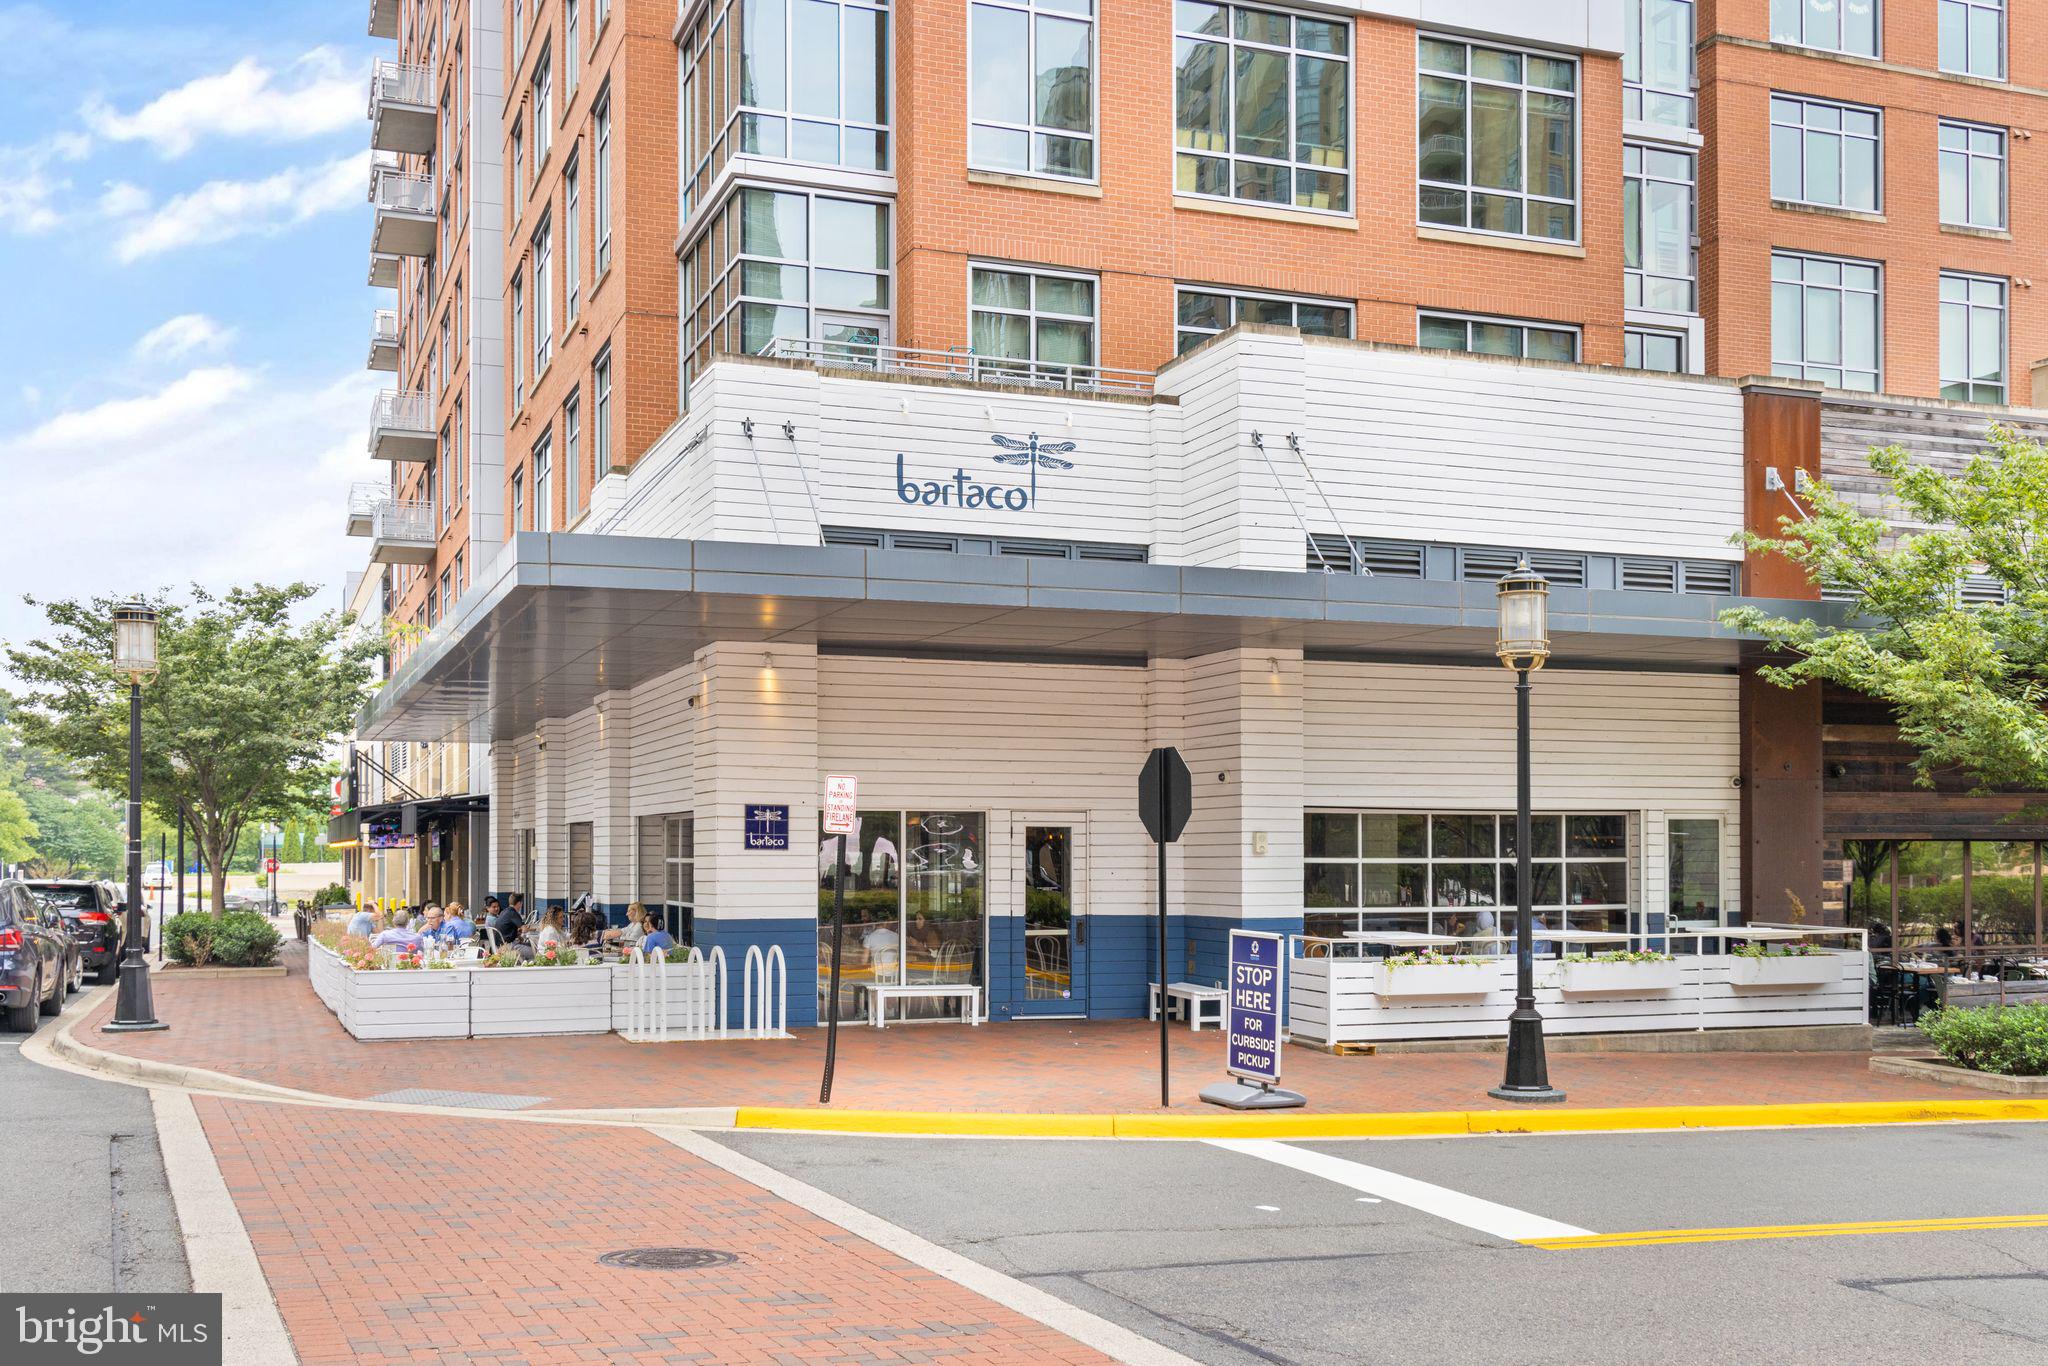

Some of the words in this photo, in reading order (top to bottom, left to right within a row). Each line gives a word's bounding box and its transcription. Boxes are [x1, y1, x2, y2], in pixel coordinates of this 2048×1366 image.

[897, 453, 1028, 511] bartaco
[828, 791, 853, 799] PARKING
[826, 804, 854, 813] STANDING
[826, 812, 854, 823] FIRELANE
[750, 832, 785, 846] bartaco
[1236, 966, 1272, 987] STOP
[1236, 990, 1272, 1011] HERE
[1244, 1017, 1262, 1031] FOR
[1231, 1034, 1275, 1052] CURBSIDE
[1238, 1052, 1271, 1069] PICKUP
